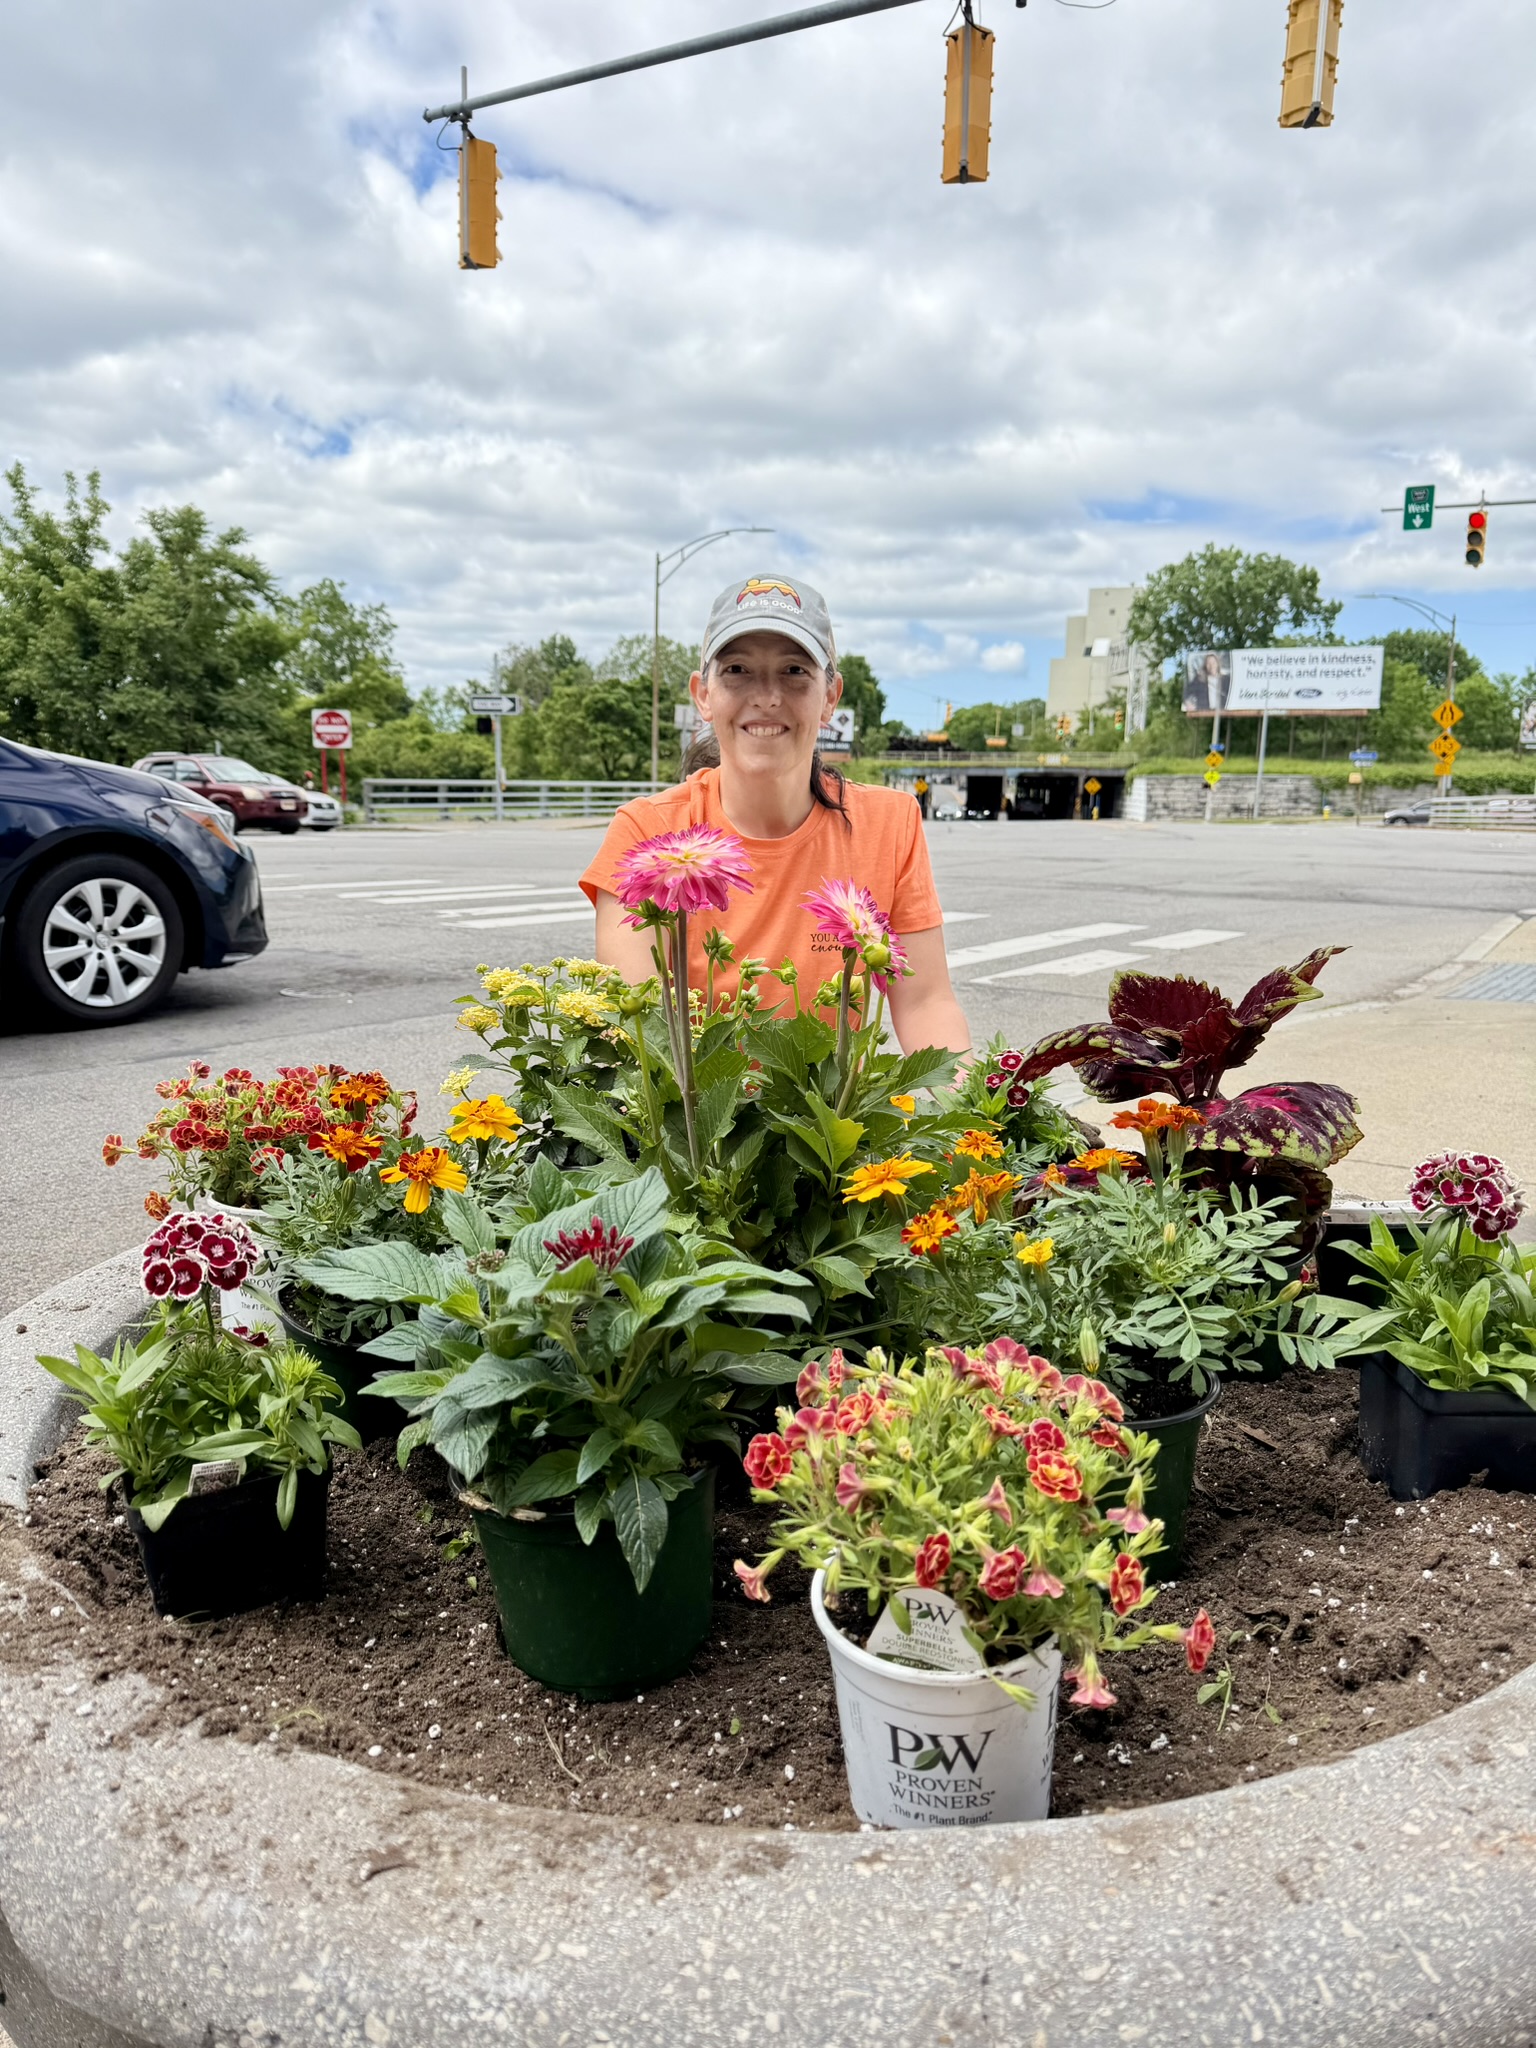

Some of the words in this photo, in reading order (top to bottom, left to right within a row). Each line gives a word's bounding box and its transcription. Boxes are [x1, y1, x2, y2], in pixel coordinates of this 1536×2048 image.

[1407, 503, 1430, 514] West
[1266, 654, 1305, 665] believe
[1308, 654, 1319, 665] in
[1321, 653, 1376, 665] kindness,
[1296, 667, 1317, 678] and
[810, 933, 831, 942] YOU
[811, 944, 843, 952] enou
[904, 1597, 957, 1626] PW
[911, 1619, 950, 1635] ROVEN
[911, 1628, 954, 1645] INNERS
[884, 1721, 996, 1775] PW
[895, 1769, 983, 1793] PROVEN
[888, 1782, 993, 1810] WINNERS
[893, 1803, 911, 1818] The
[914, 1811, 925, 1822] #1
[929, 1814, 956, 1825] Plant
